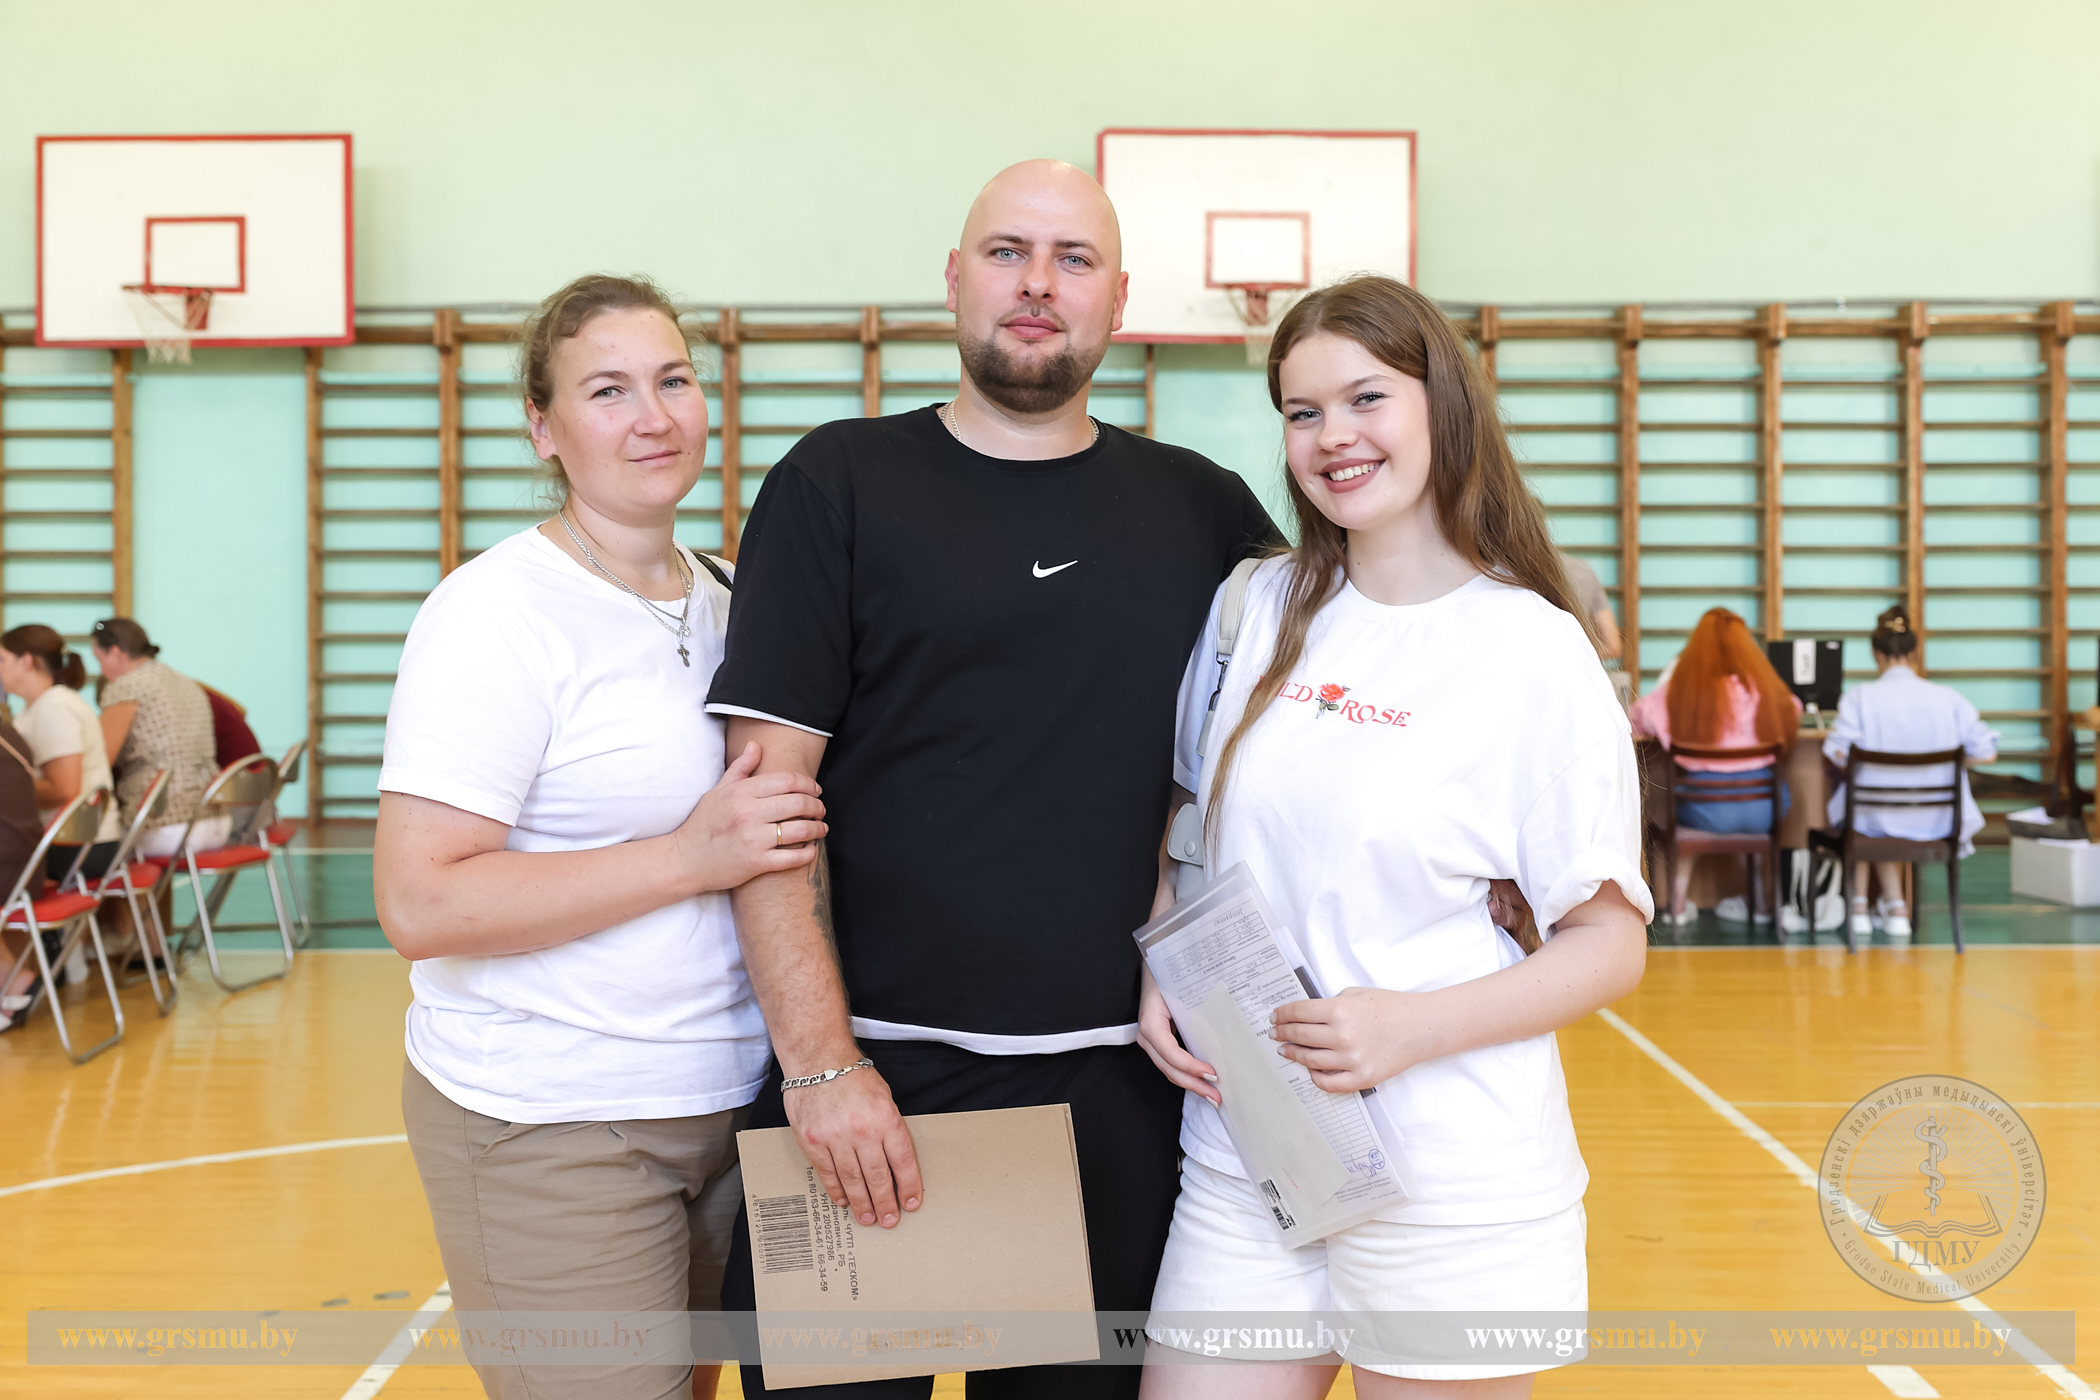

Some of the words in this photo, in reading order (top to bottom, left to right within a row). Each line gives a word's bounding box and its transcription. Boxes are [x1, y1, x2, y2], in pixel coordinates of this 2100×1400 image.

[1339, 699, 1411, 727] ROSE
[806, 1165, 814, 1182] Тел
[820, 1192, 830, 1211] УНП
[841, 1204, 850, 1221] ель
[831, 1201, 843, 1252] рановичи,
[838, 1253, 846, 1267] РБ
[845, 1224, 854, 1249] ЧУТП
